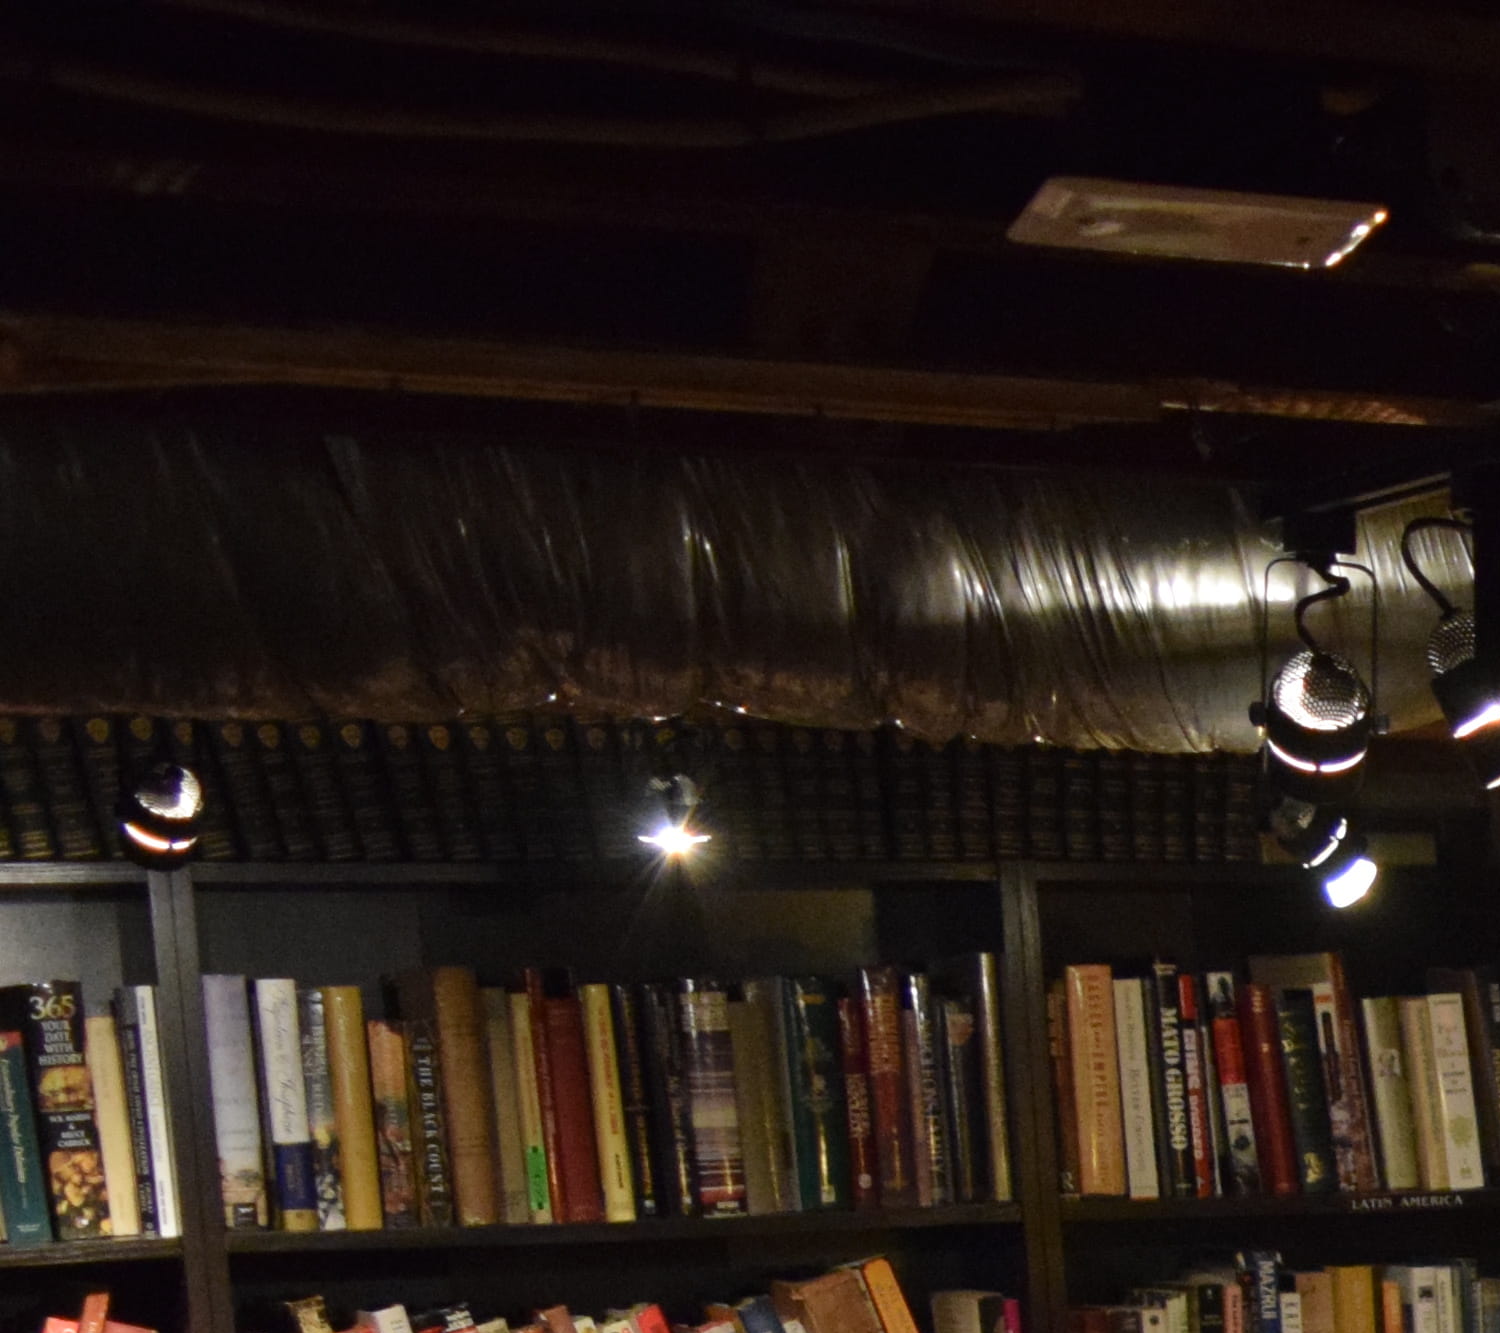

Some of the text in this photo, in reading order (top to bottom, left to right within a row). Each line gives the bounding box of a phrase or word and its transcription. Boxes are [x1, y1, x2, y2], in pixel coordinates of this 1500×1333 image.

[30, 993, 74, 1021] 365
[38, 1052, 84, 1067] HISTORY
[1159, 1007, 1189, 1150] MATO GROSSO
[1351, 1194, 1464, 1211] LATIN AMERICA
